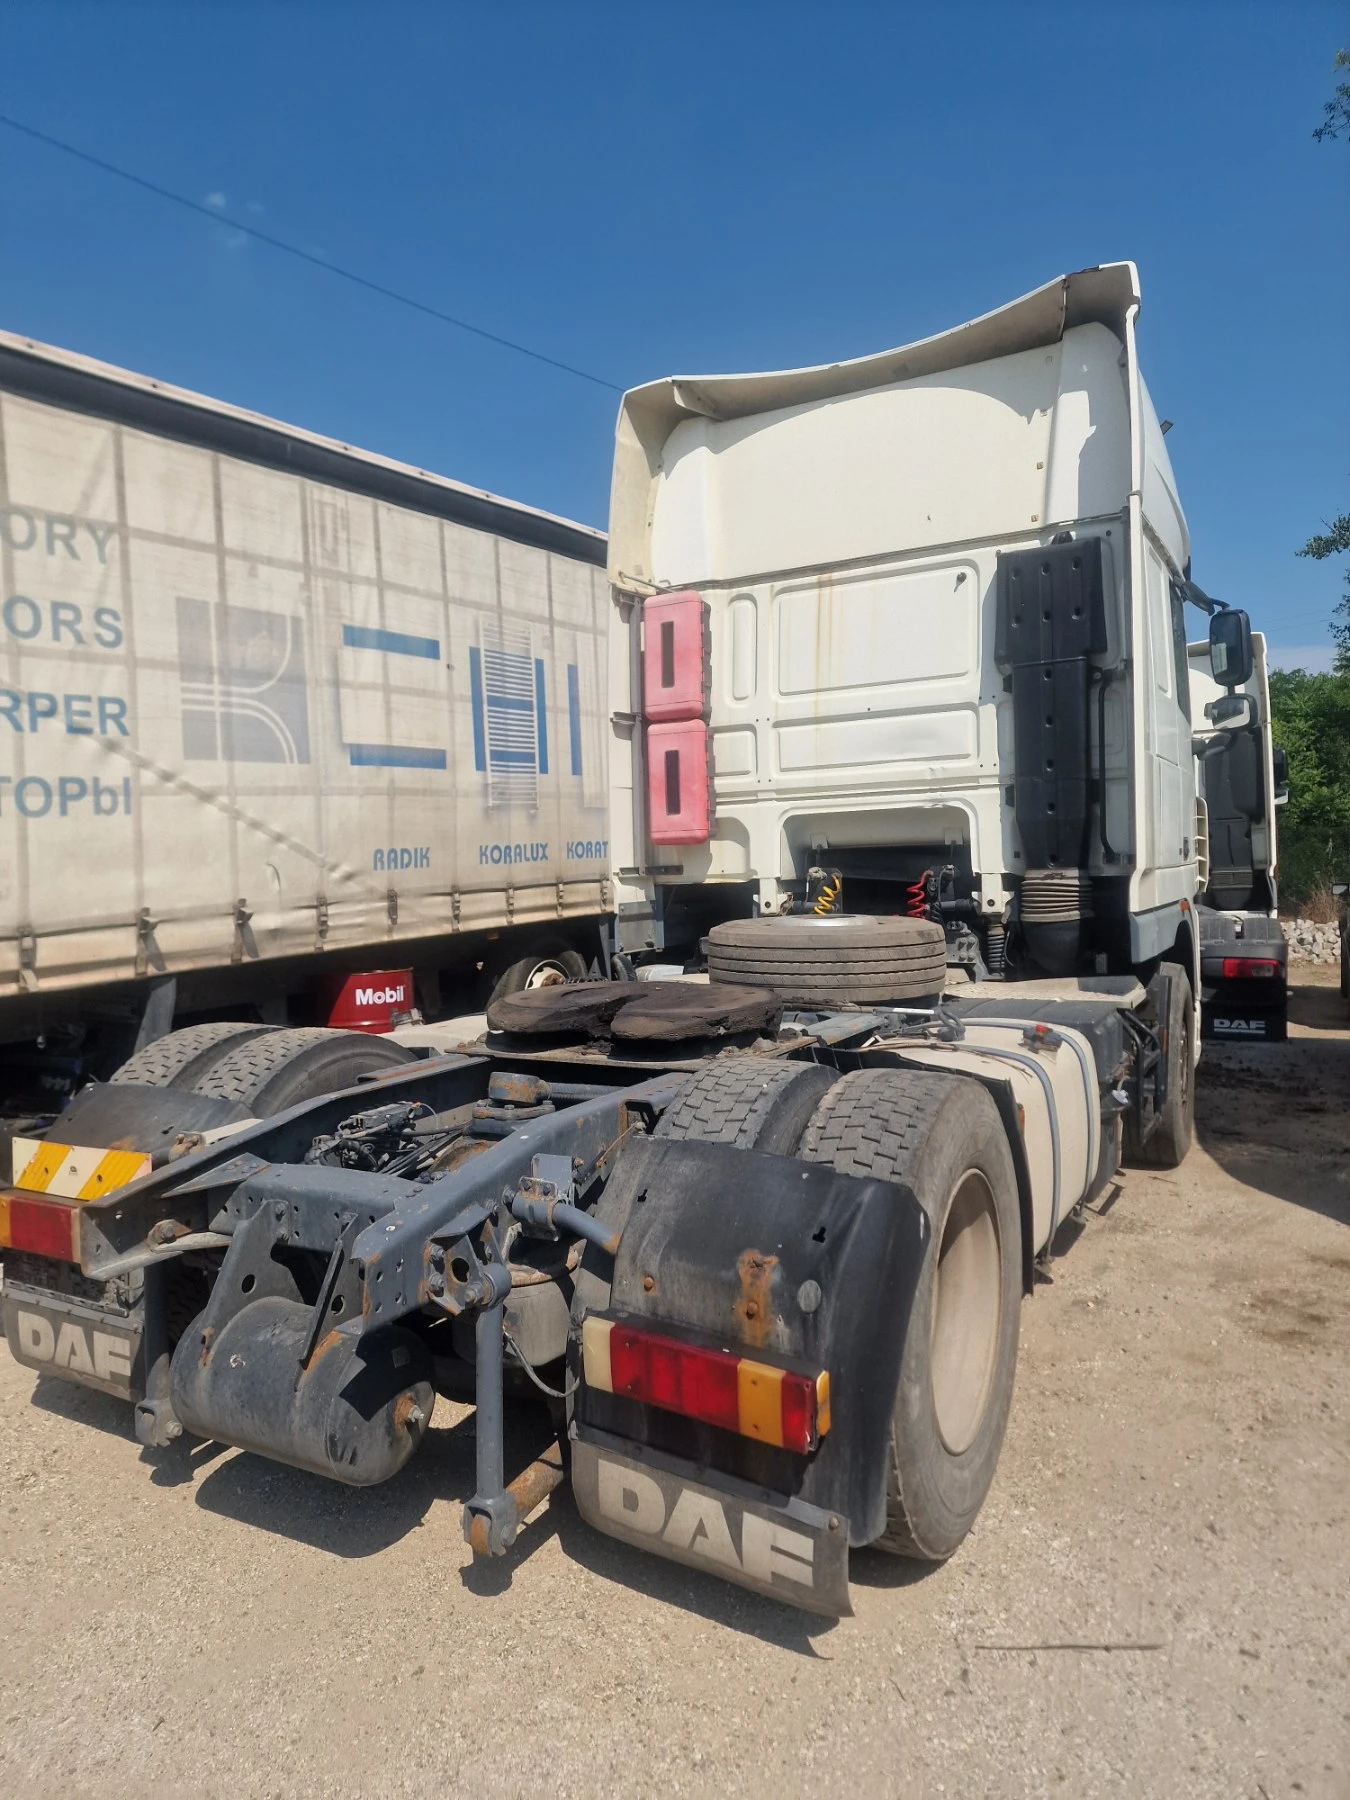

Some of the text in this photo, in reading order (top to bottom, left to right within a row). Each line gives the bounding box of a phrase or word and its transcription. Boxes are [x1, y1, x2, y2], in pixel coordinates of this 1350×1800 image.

[3, 595, 123, 649] ORS
[373, 847, 431, 871] RADIK
[478, 842, 549, 865] KORALUX
[566, 840, 609, 860] KORAT
[355, 985, 404, 1006] Mobil
[1213, 1018, 1266, 1029] DAF
[17, 1310, 131, 1381] DAF
[598, 1458, 814, 1587] DAF
